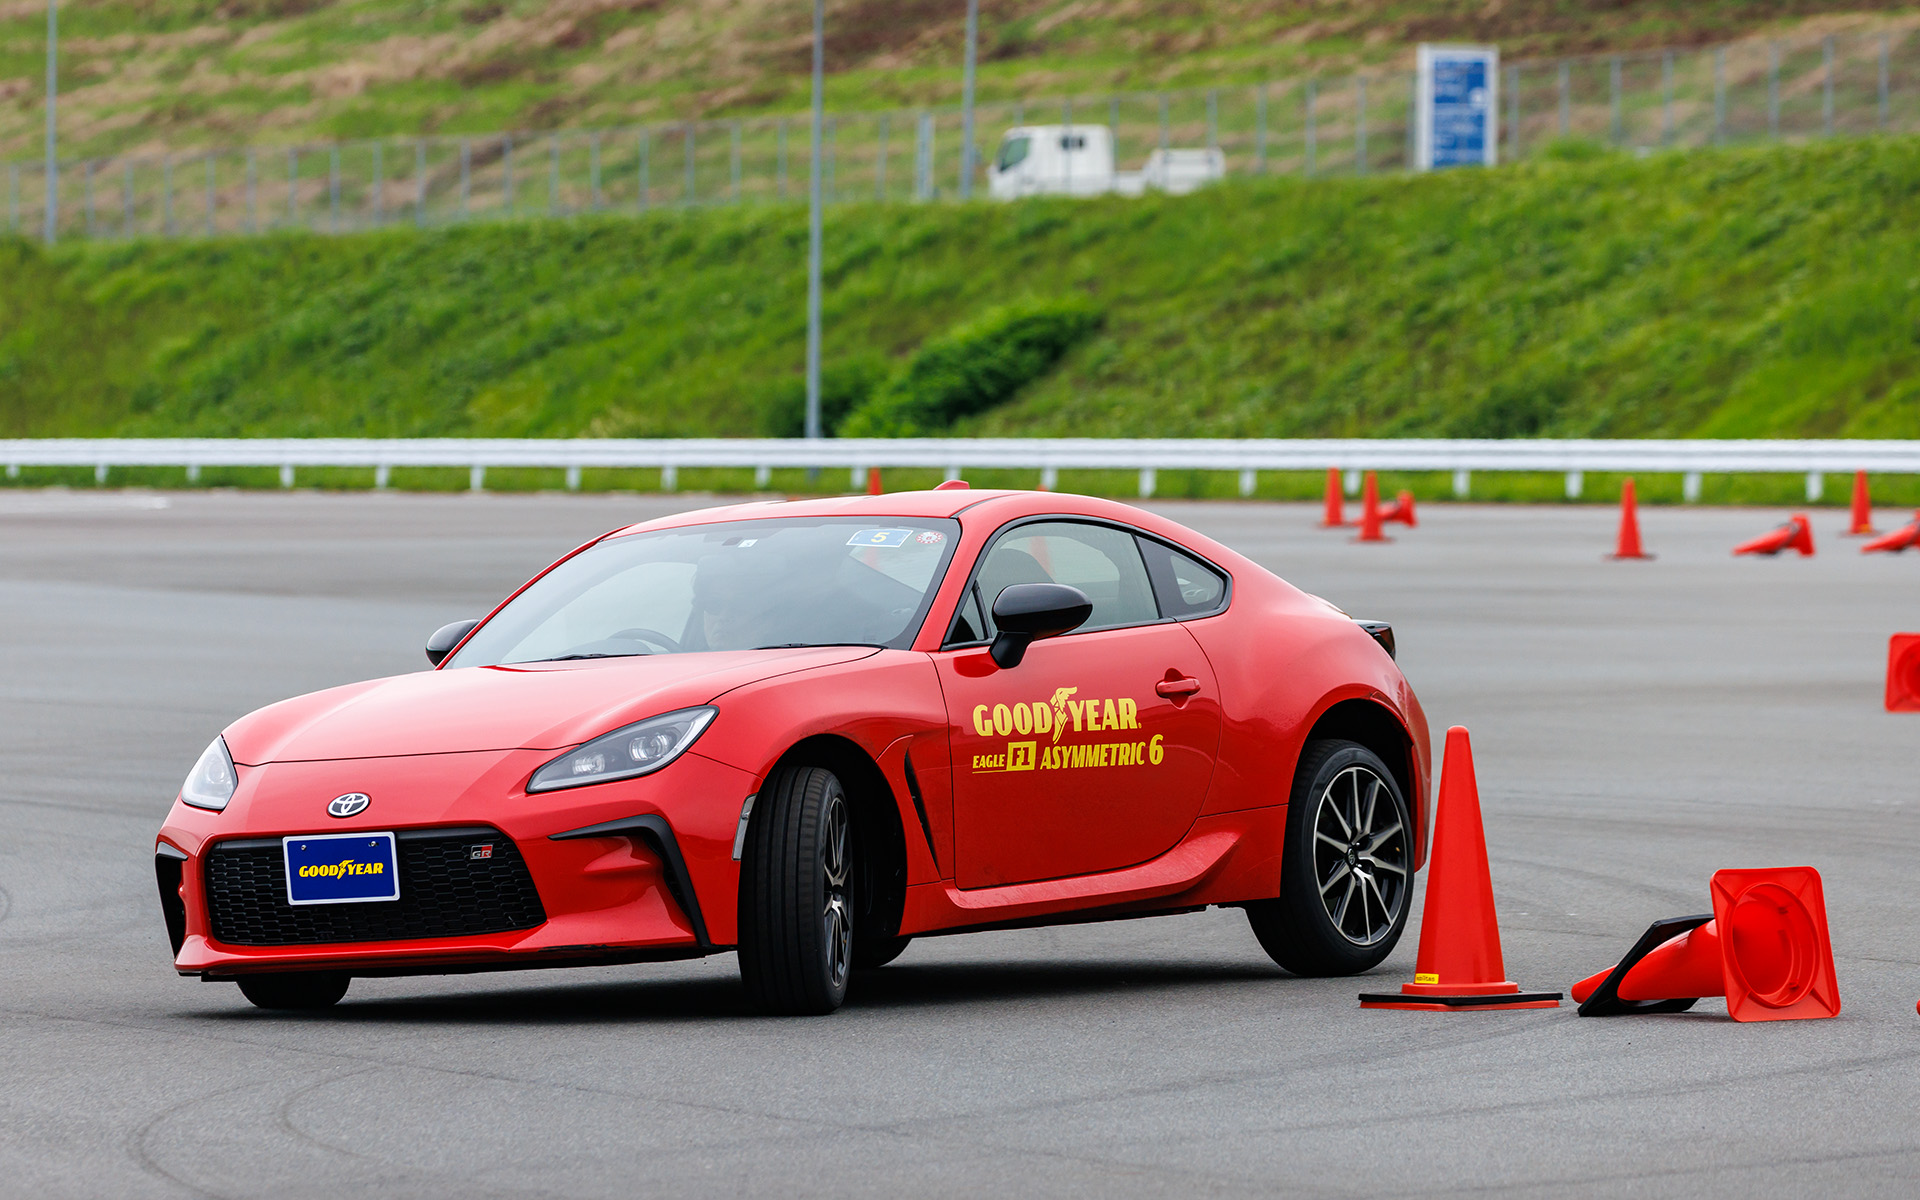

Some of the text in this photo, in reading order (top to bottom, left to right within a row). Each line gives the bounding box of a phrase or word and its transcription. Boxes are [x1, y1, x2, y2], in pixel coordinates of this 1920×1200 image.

[871, 532, 890, 543] 5
[972, 734, 1164, 770] EAGLE F1 ASYMMETRIC 6
[472, 850, 492, 859] GR
